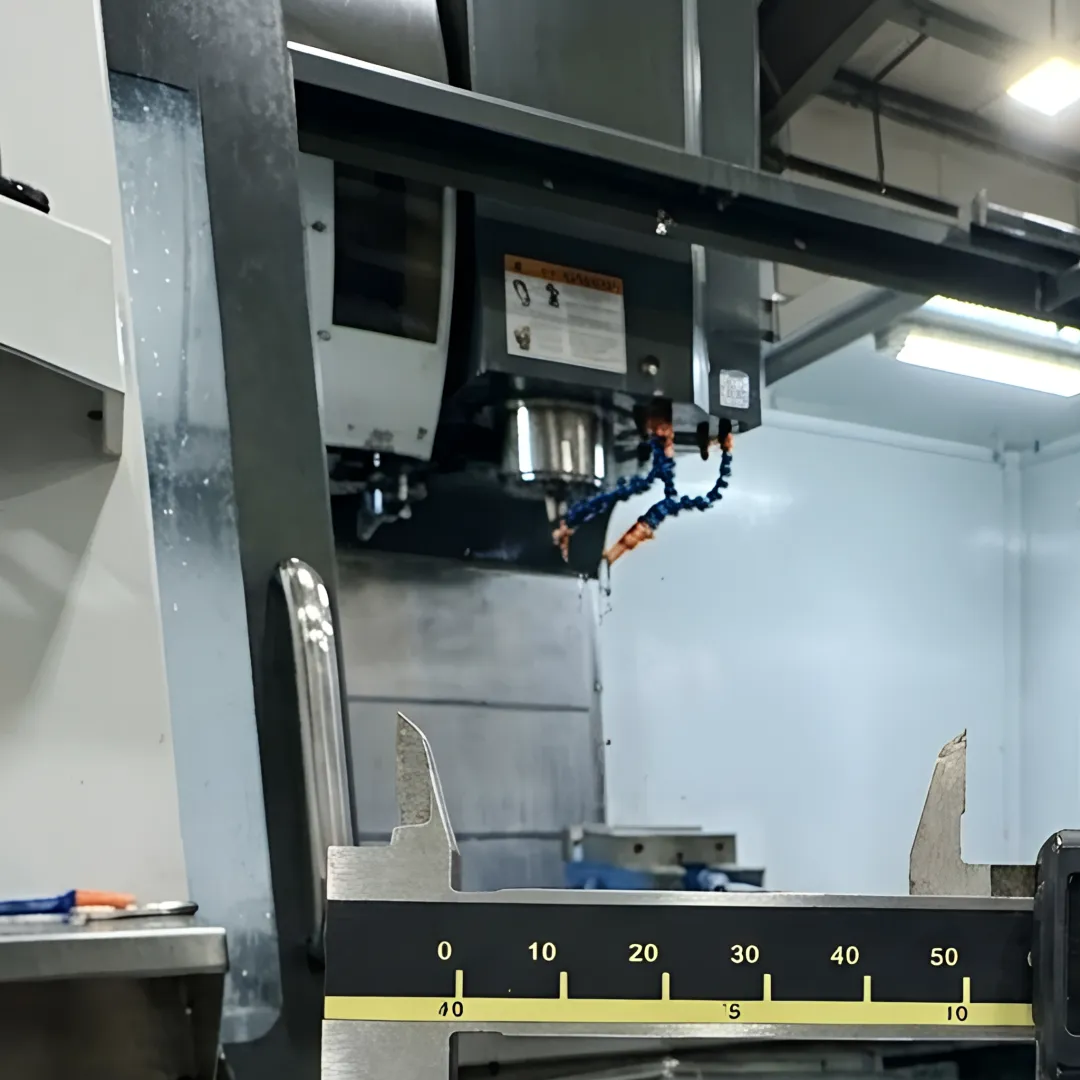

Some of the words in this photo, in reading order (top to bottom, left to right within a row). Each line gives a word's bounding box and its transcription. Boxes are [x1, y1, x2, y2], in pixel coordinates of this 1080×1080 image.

[437, 940, 453, 961] 0
[528, 941, 557, 962] 10
[628, 943, 659, 963] 20
[730, 944, 760, 964] 30
[830, 945, 860, 965] 40
[930, 947, 959, 967] 50
[947, 1005, 968, 1022] 10
